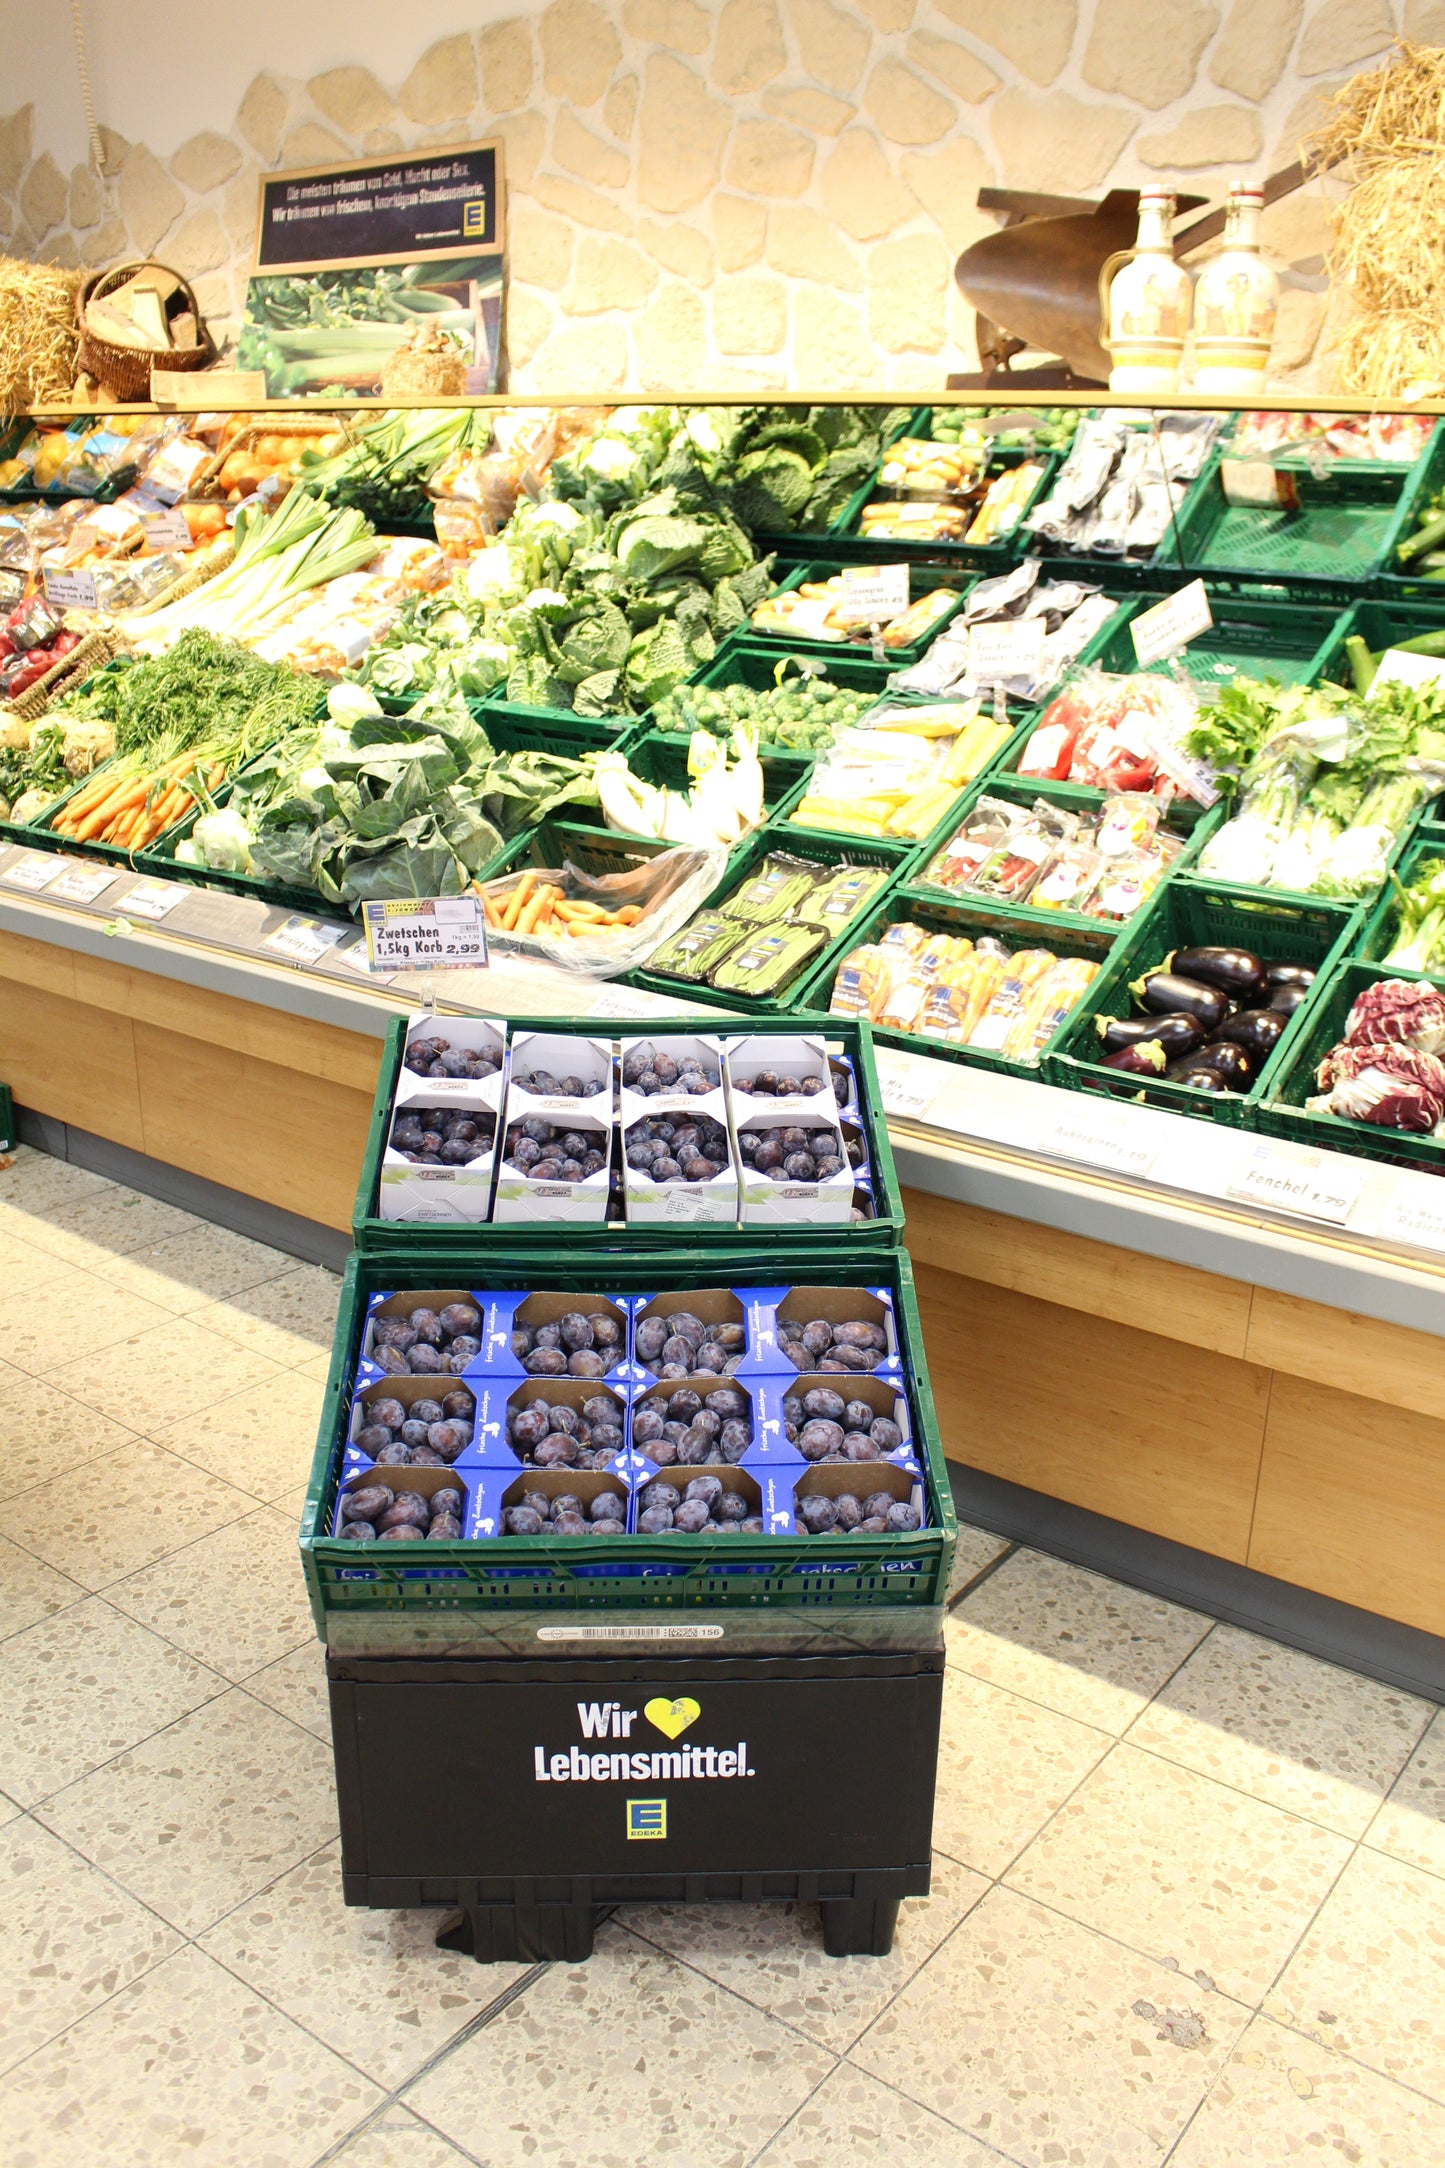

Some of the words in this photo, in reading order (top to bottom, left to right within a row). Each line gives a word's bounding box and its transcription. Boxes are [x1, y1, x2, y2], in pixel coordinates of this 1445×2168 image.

[287, 186, 300, 200] Die
[301, 183, 332, 199] meisten
[333, 179, 367, 195] träumen
[367, 177, 382, 190] von
[431, 165, 451, 180] oder
[272, 207, 286, 222] Wir
[287, 205, 320, 220] träumen
[377, 925, 440, 940] Zwetschen
[376, 942, 410, 957] 1,5kg
[415, 939, 442, 954] Korb
[446, 943, 480, 955] 2,99
[1055, 1126, 1118, 1148] Auberginen
[1245, 1170, 1309, 1195] Fenchel
[577, 1702, 638, 1738] Wir
[534, 1742, 756, 1781] Lebensmittel.
